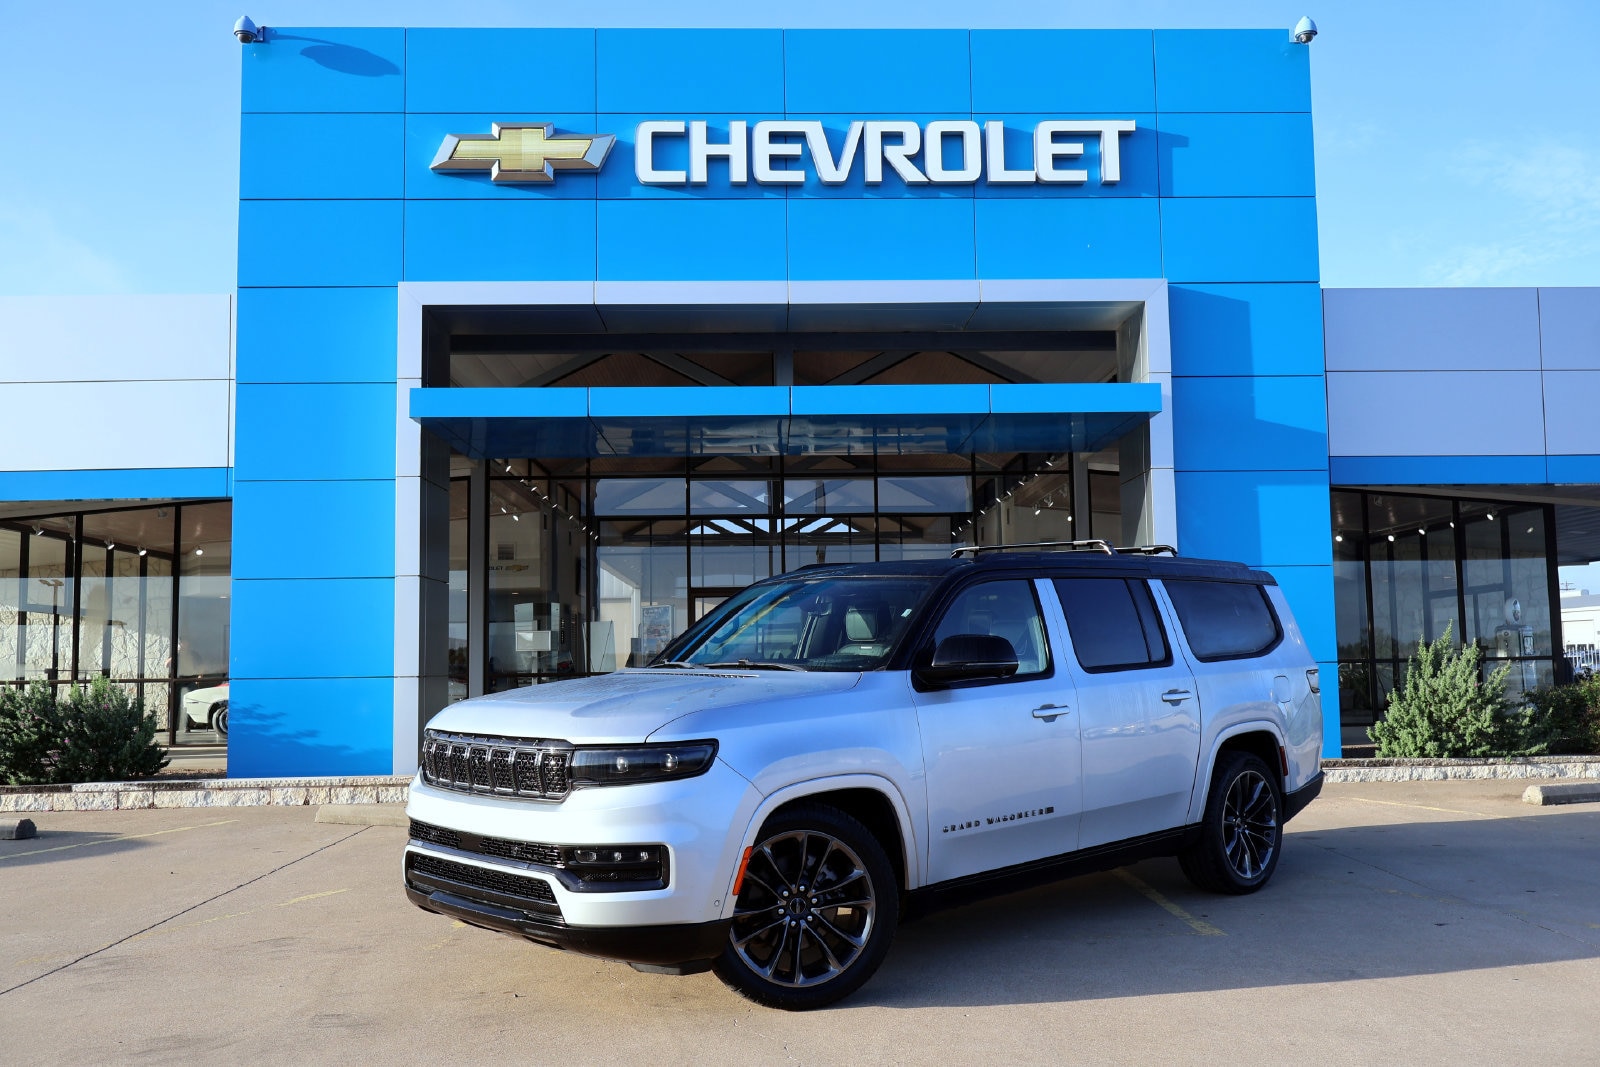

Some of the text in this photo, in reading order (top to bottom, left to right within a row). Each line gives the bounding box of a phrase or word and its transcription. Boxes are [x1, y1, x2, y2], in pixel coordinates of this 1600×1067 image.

[634, 120, 1136, 186] CHEVROLET
[942, 808, 1044, 833] GRAND WAGONEER
